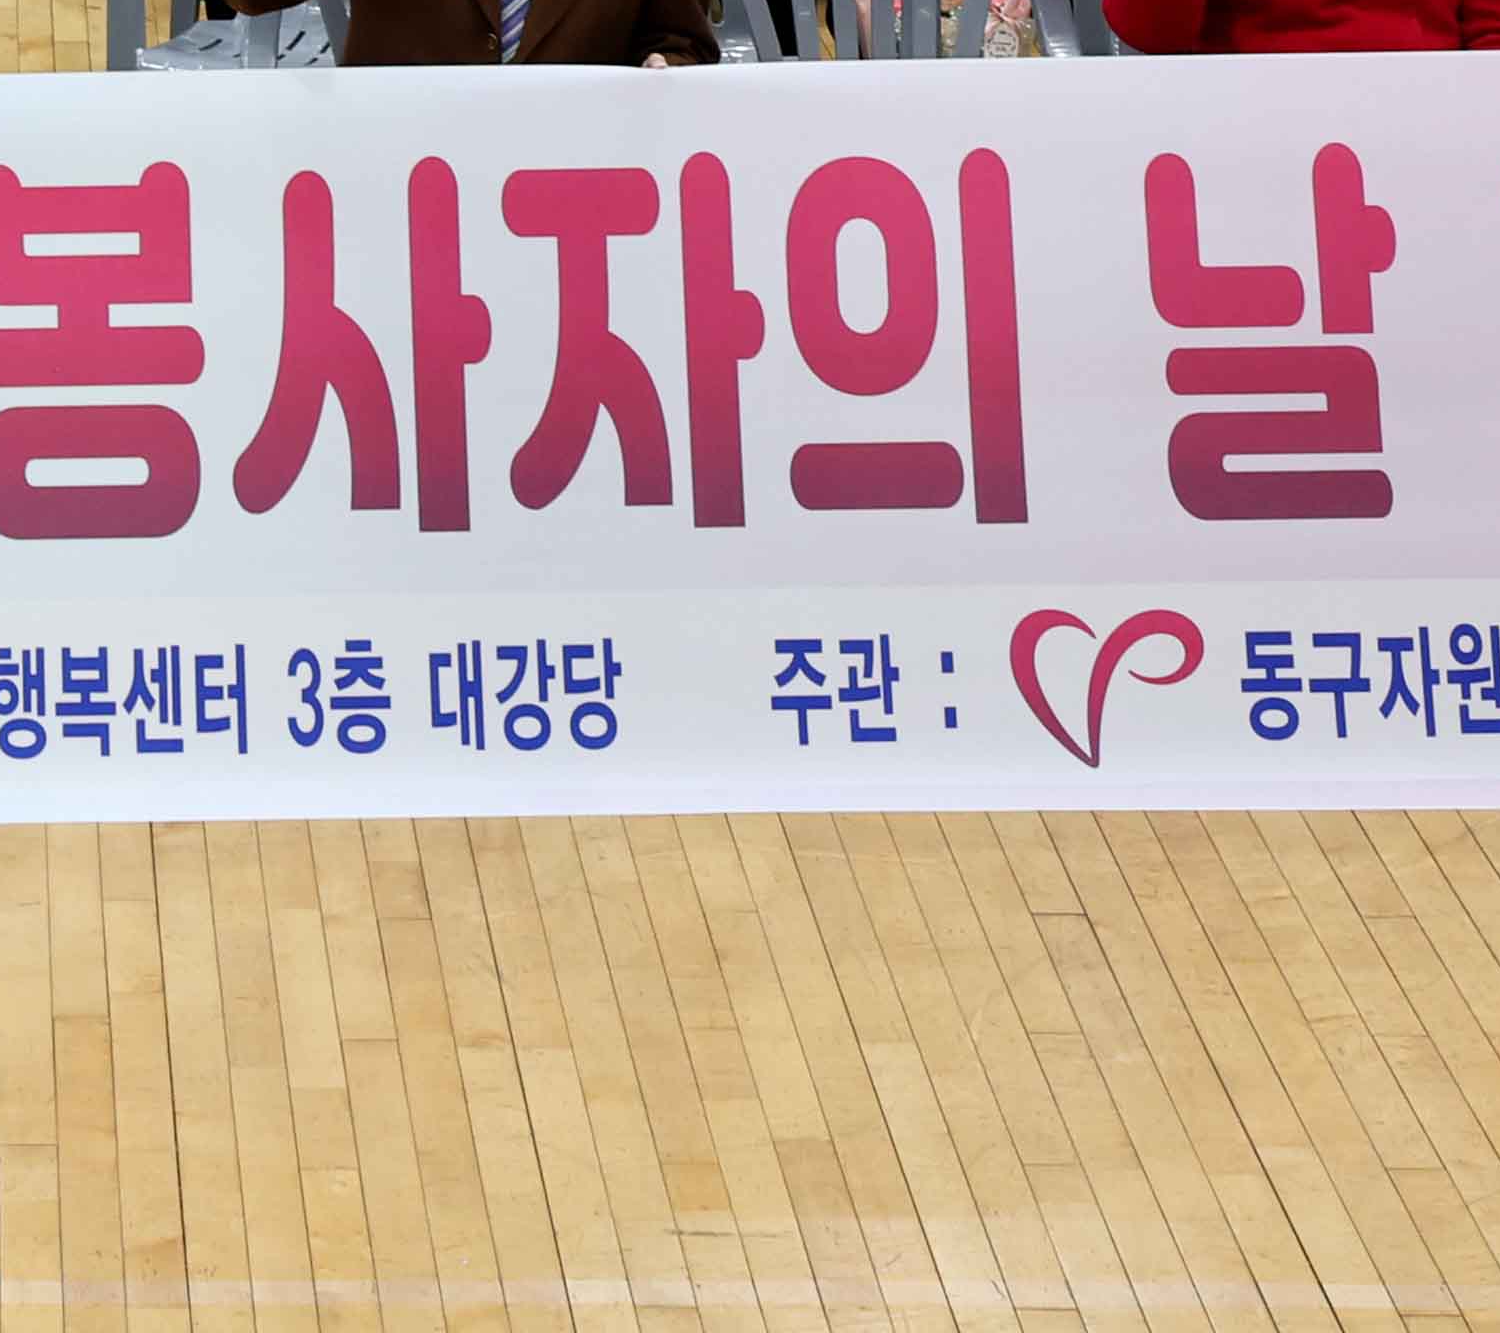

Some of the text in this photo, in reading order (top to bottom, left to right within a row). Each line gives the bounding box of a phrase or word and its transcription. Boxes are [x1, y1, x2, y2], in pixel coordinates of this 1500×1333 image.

[1145, 143, 1397, 519] 날
[287, 639, 392, 754] 3층
[428, 637, 622, 751] 대강당
[770, 633, 900, 746] 주관
